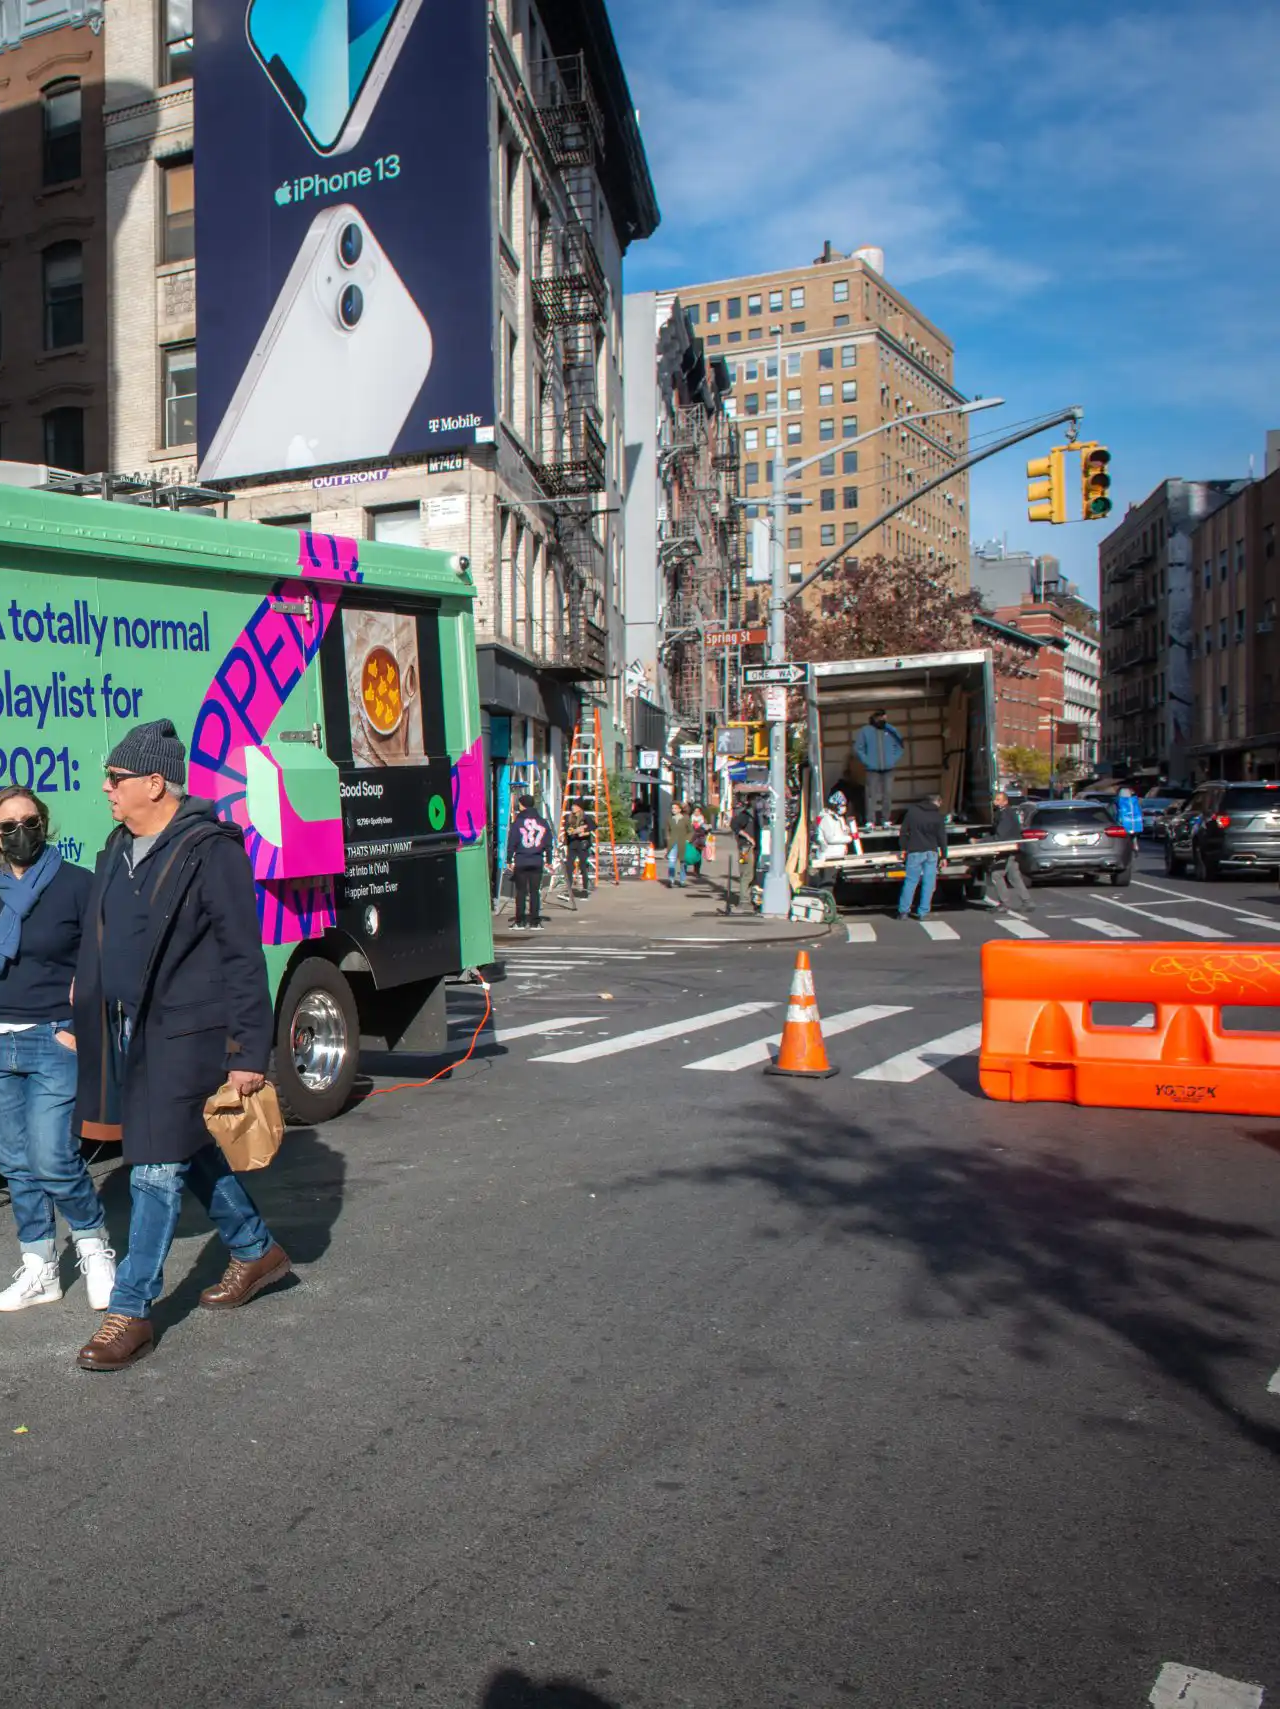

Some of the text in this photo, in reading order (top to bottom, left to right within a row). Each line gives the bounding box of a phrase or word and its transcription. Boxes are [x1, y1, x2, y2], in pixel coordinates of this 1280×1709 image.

[293, 154, 401, 202] iPhone 13
[440, 414, 482, 432] Mobile
[313, 469, 388, 489] OUTFRONT
[7, 599, 108, 657] totally
[113, 610, 210, 652] normal
[706, 631, 751, 644] Spring St
[751, 669, 799, 680] ONE WAY
[100, 673, 144, 718] for
[339, 780, 384, 798] Good Soup
[56, 836, 82, 862] tify
[347, 846, 369, 858] THATS
[369, 844, 389, 856] WHAT
[393, 841, 413, 853] WANT
[344, 861, 390, 877] Get Into It (Yuh)
[345, 881, 399, 899] Happier Than Ever
